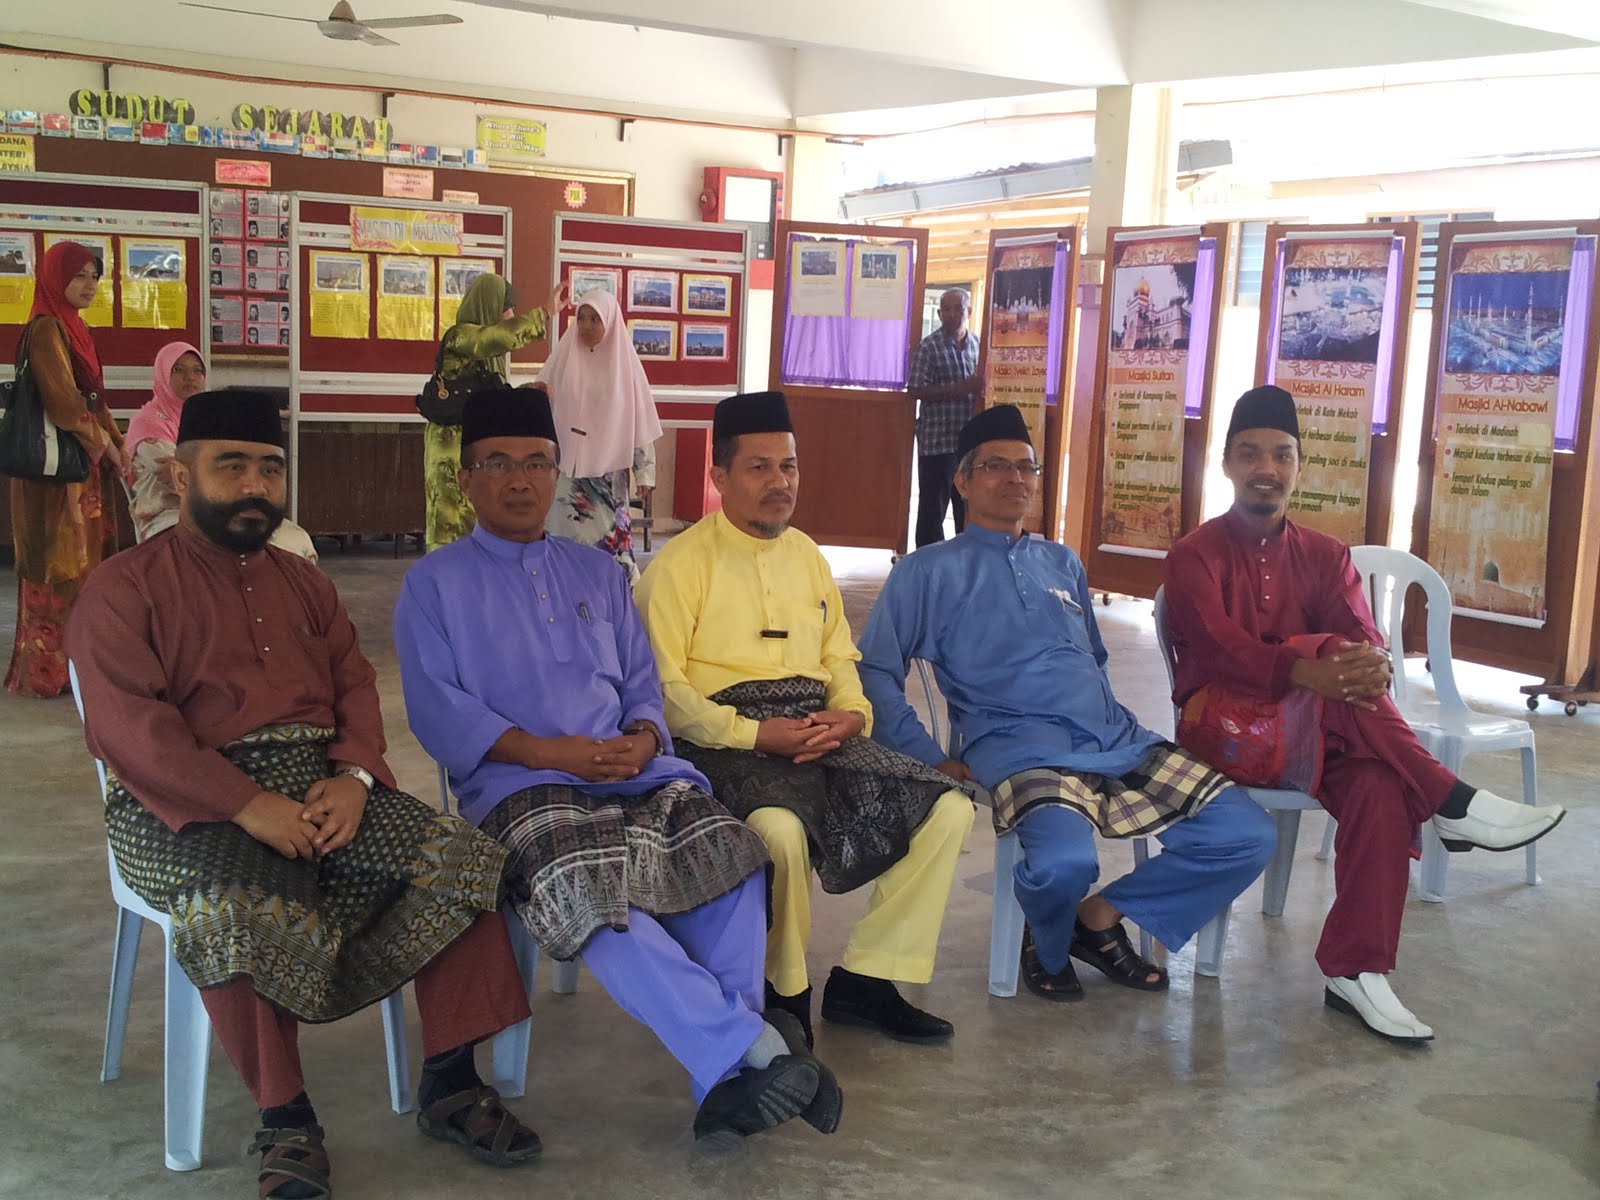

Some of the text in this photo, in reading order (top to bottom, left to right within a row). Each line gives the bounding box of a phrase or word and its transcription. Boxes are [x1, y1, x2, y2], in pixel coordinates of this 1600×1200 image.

[77, 89, 389, 142] SUDUT SEJARAH
[485, 120, 540, 134] Where There's
[0, 136, 27, 146] DANA
[484, 139, 513, 151] There's
[0, 150, 26, 159] TERI
[0, 163, 30, 172] AYSIA
[1127, 370, 1175, 384] Masjid Sultan
[1292, 381, 1365, 398] Masjid Al Haram
[1458, 397, 1549, 414] Masjid Al-Nabawi
[1455, 423, 1519, 437] Terletak di Madinah
[1453, 448, 1475, 461] Masjid
[1475, 448, 1496, 461] kedua
[1497, 449, 1523, 463] terbesar
[1524, 451, 1532, 463] di
